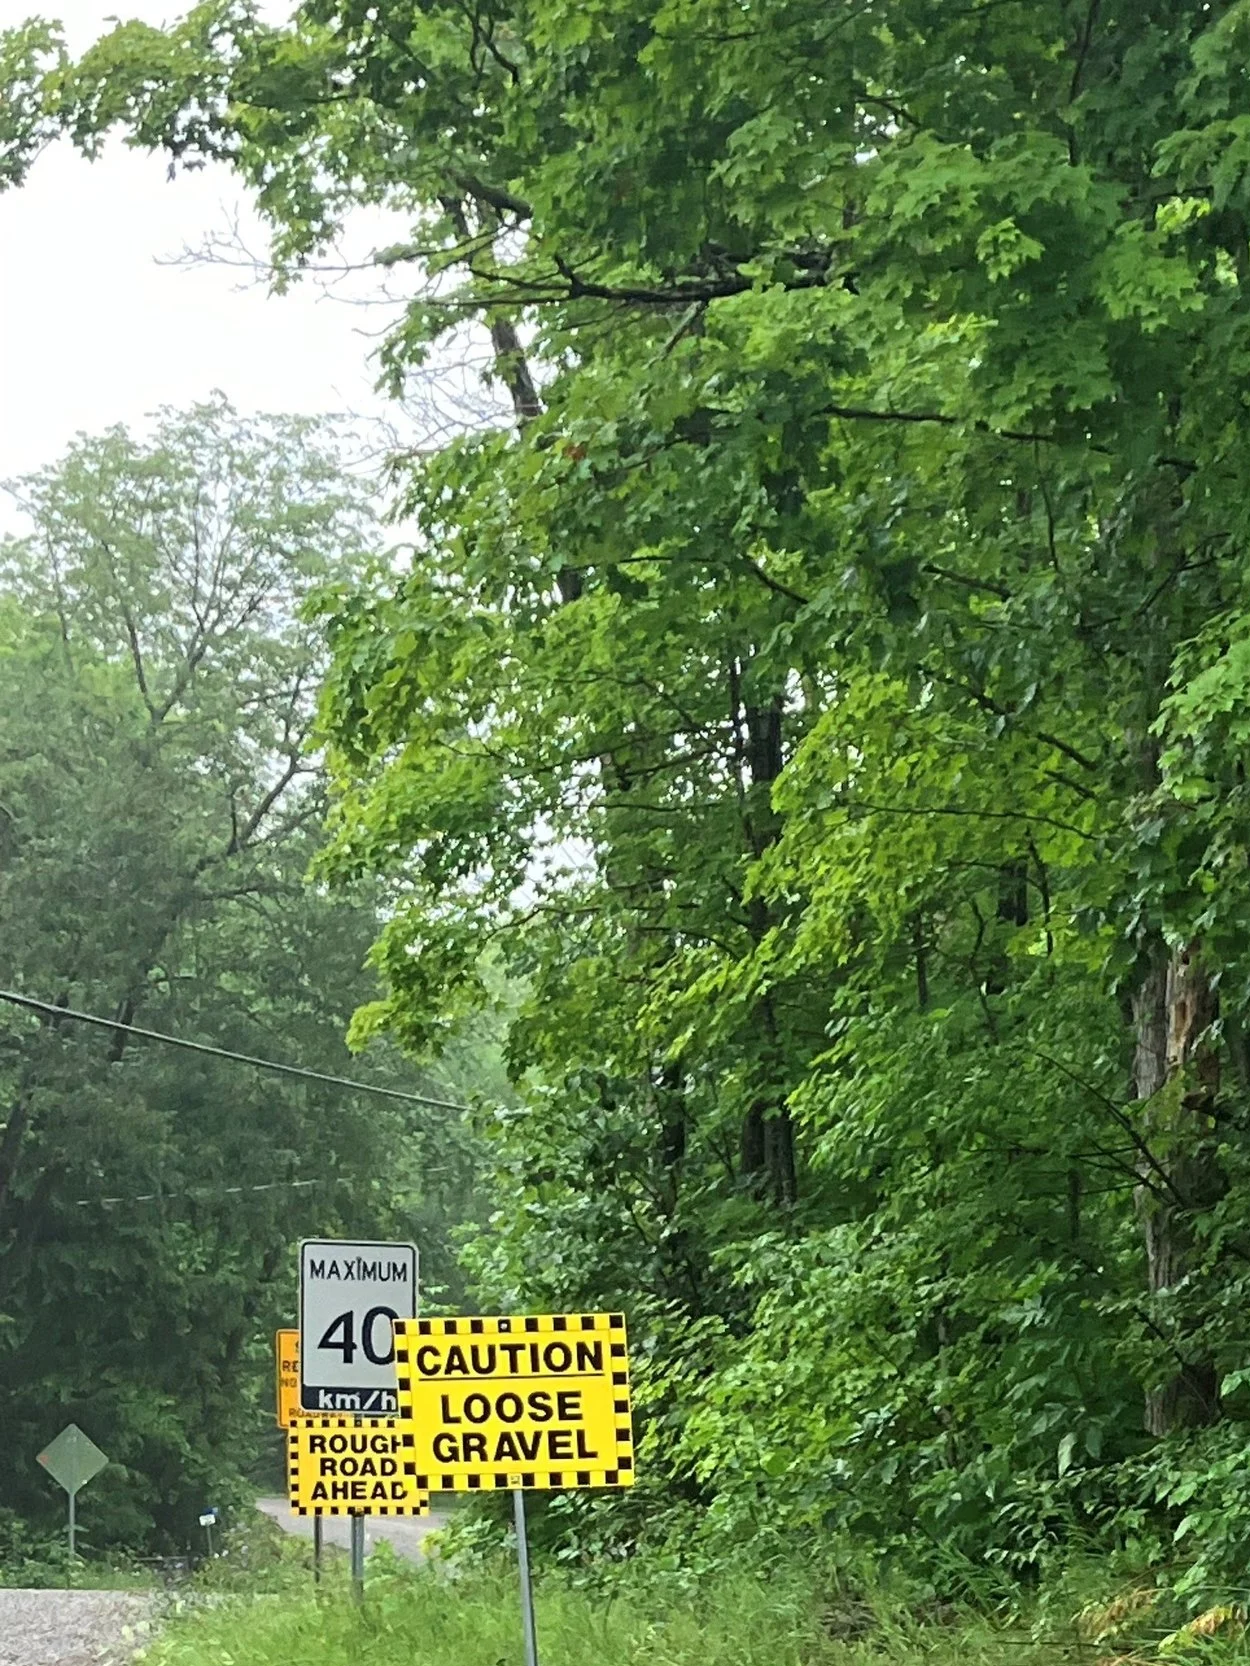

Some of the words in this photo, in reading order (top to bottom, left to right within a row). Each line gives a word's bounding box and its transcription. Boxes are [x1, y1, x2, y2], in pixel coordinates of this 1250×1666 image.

[310, 1258, 407, 1282] MAXIMUM
[318, 1306, 398, 1365] 40
[417, 1341, 603, 1376] CAUTION
[319, 1389, 397, 1411] km/h
[441, 1391, 583, 1424] LOOSE
[433, 1429, 598, 1463] GRAVEL
[320, 1457, 397, 1477] ROAD
[311, 1481, 408, 1501] AHEAD
